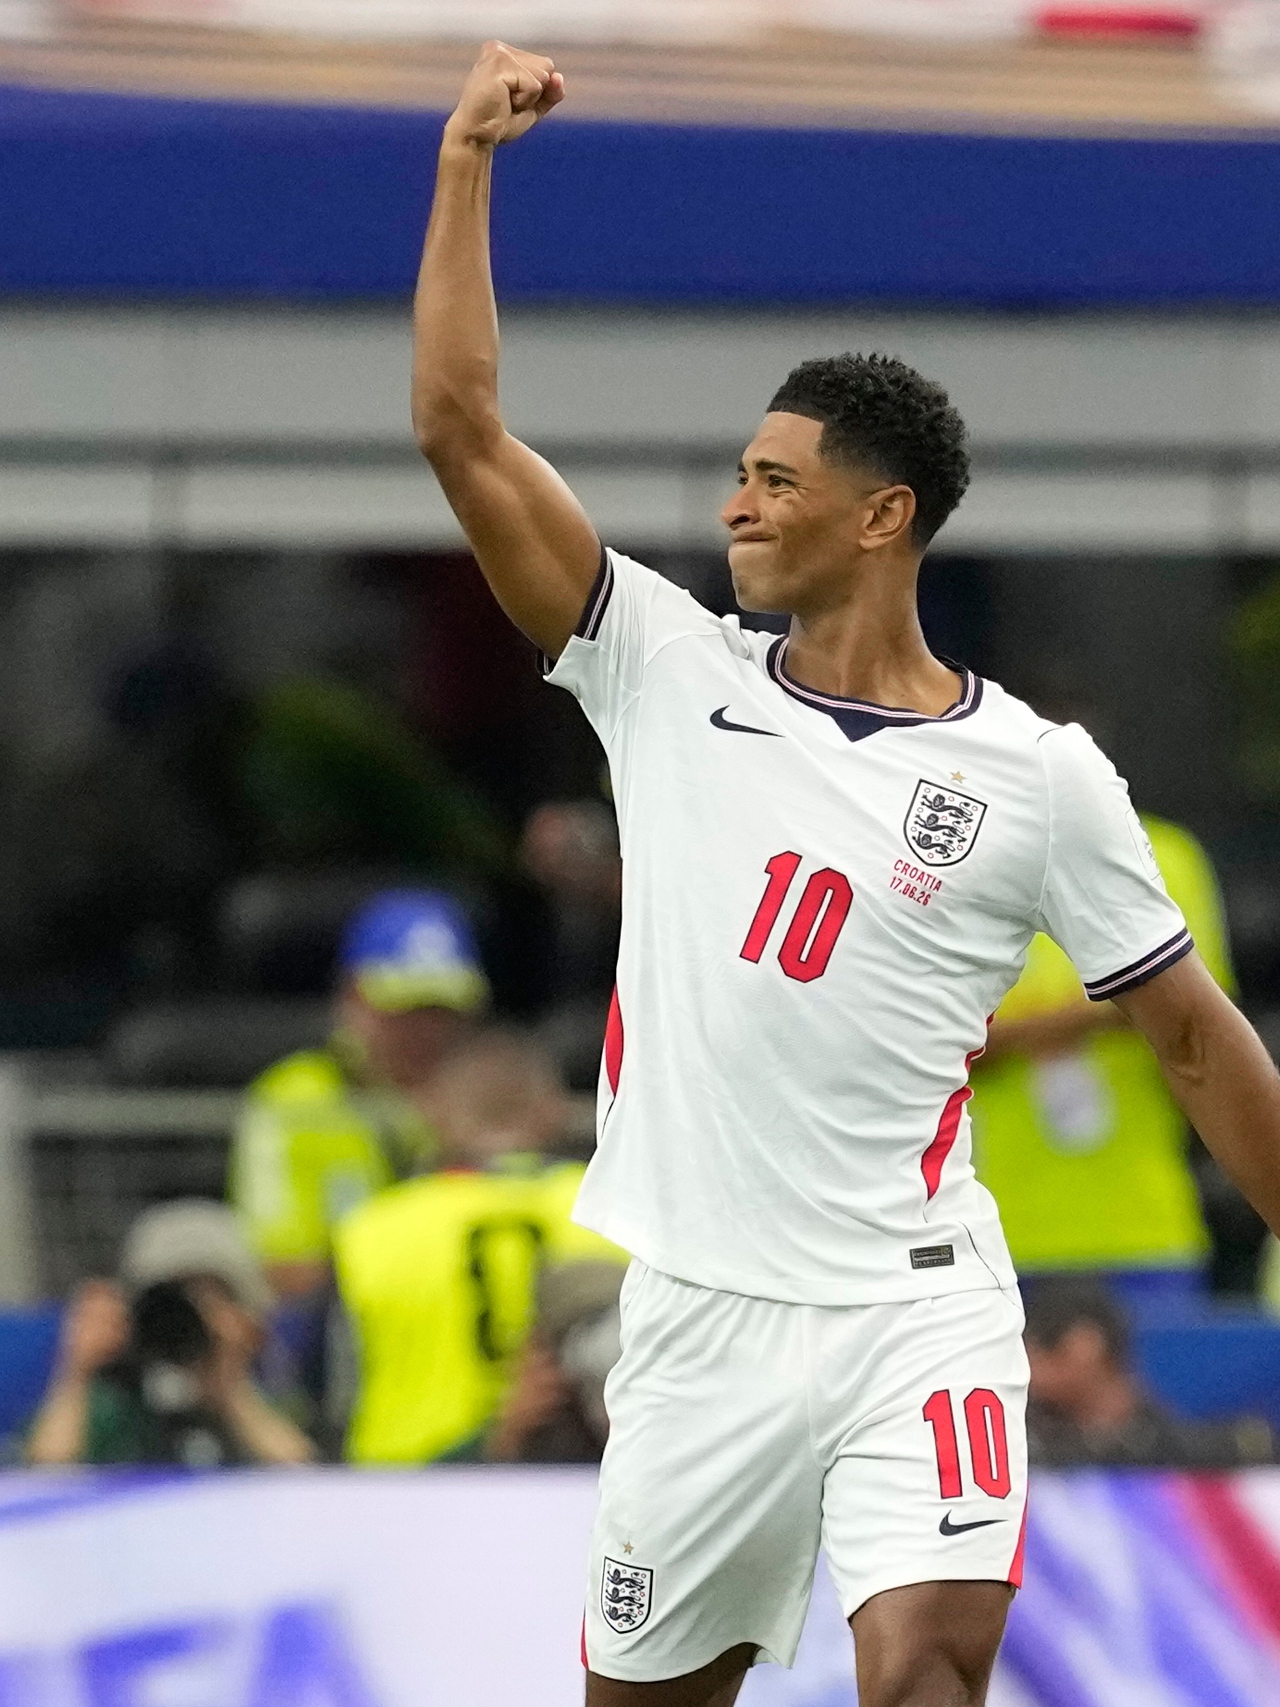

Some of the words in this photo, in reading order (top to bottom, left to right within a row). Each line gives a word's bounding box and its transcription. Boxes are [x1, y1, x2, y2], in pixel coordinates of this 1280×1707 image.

[889, 876, 932, 907] 17.06.26
[893, 859, 942, 892] CROATIA
[739, 850, 853, 983] 10
[922, 1387, 1012, 1500] 10
